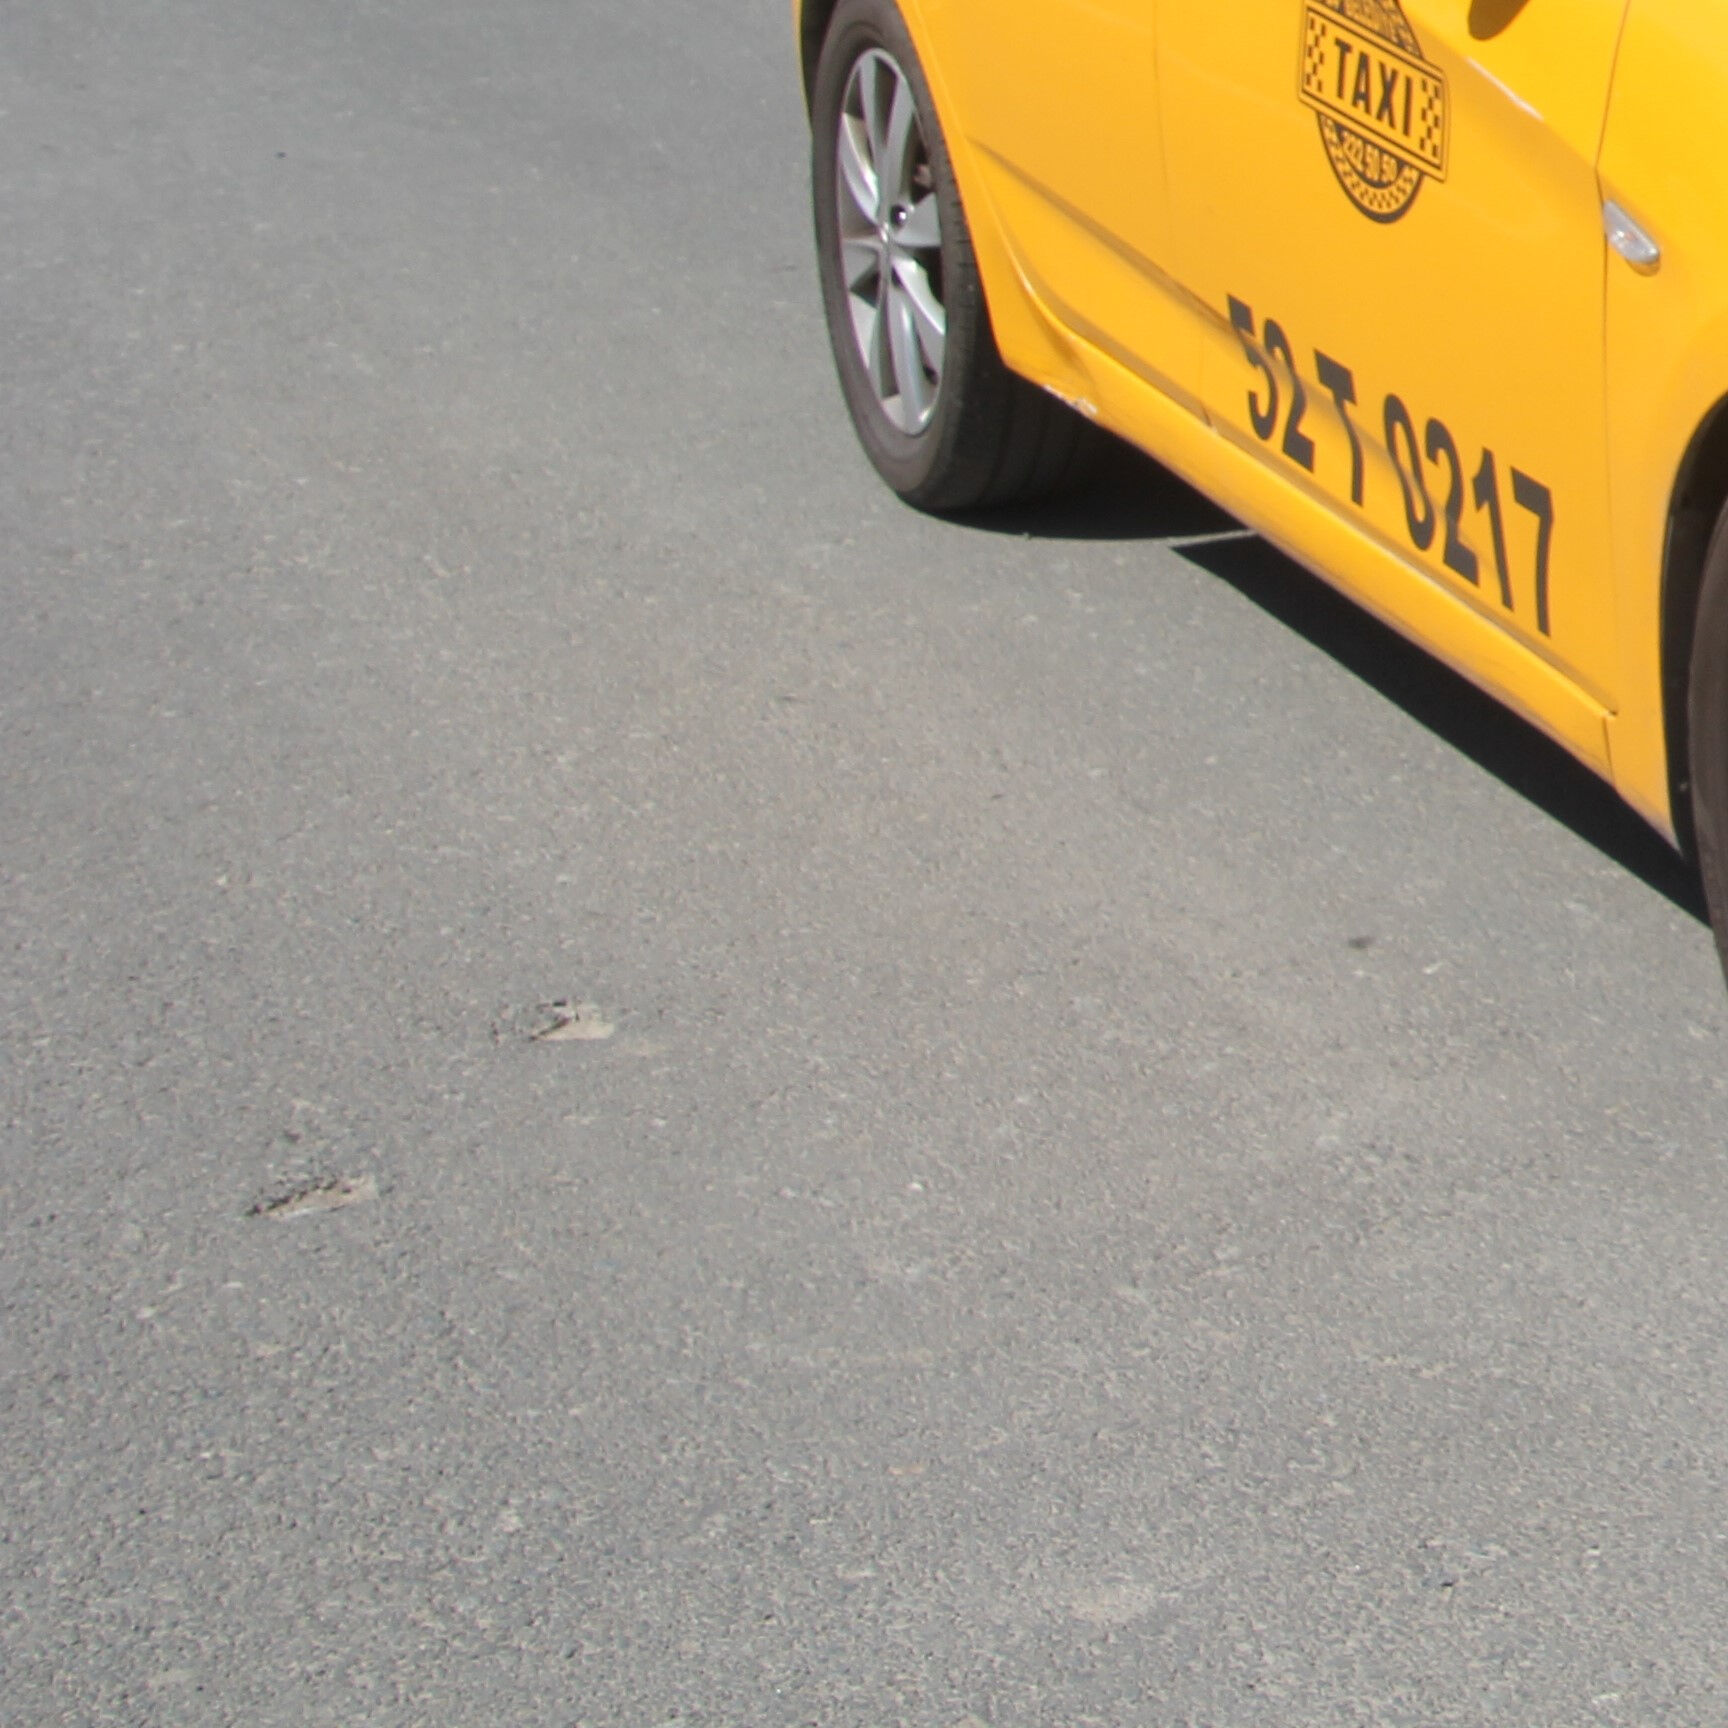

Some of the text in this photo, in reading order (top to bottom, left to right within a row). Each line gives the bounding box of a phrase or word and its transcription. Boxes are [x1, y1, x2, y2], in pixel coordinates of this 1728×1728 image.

[1334, 37, 1412, 137] TAXI
[1226, 292, 1554, 639] 52 T 0217
